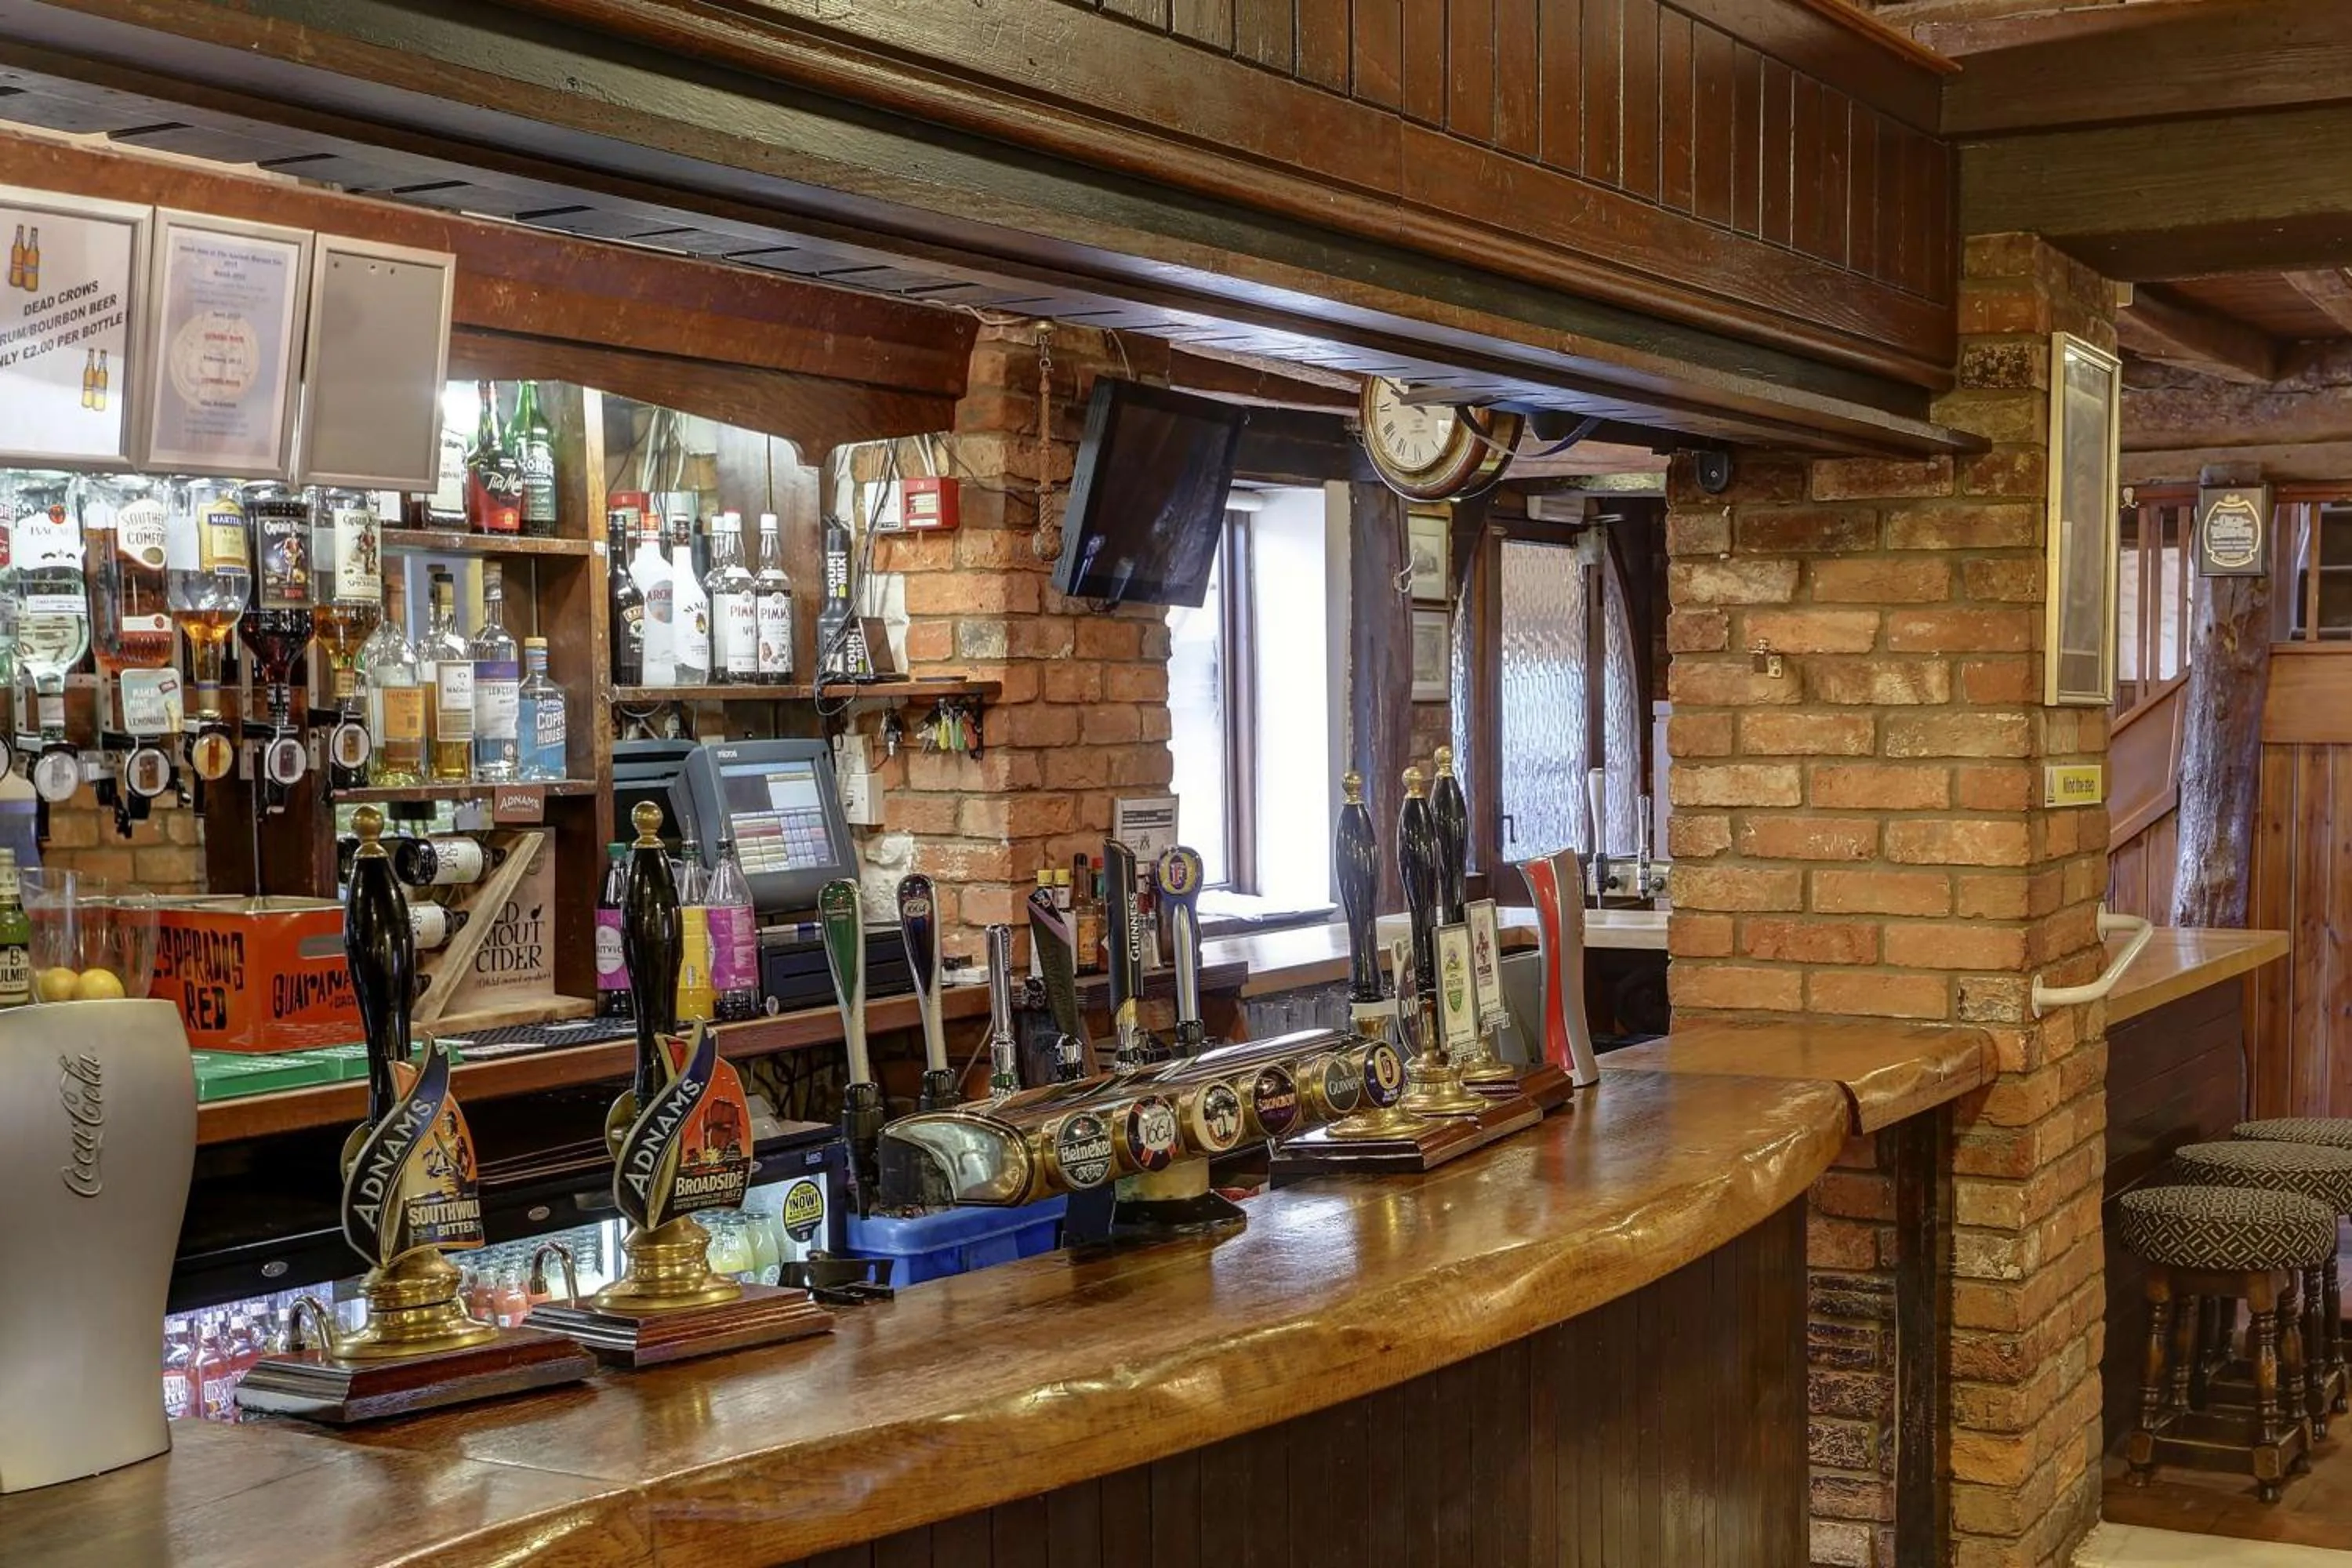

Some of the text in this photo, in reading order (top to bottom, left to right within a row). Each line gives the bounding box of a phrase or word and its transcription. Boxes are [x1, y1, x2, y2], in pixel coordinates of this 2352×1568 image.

[24, 281, 99, 317] DEAD CROWS
[89, 294, 118, 314] BEER
[23, 339, 54, 360] £2.00
[57, 328, 80, 348] PER
[82, 312, 123, 339] BOTTLE
[121, 511, 164, 526] SOUTHE
[838, 556, 847, 585] MIX
[848, 633, 857, 672] SOUR
[499, 794, 541, 809] ADNAMS
[1129, 891, 1141, 962] GUINNESS
[476, 945, 543, 973] CIDER
[184, 981, 228, 1031] RED
[59, 1053, 104, 1198] Coca-Cola
[625, 1079, 701, 1201] ADNAMS
[353, 1099, 432, 1232] ADNAMS
[674, 1171, 744, 1197] BROADSIDE
[437, 1220, 476, 1237] BITTER
